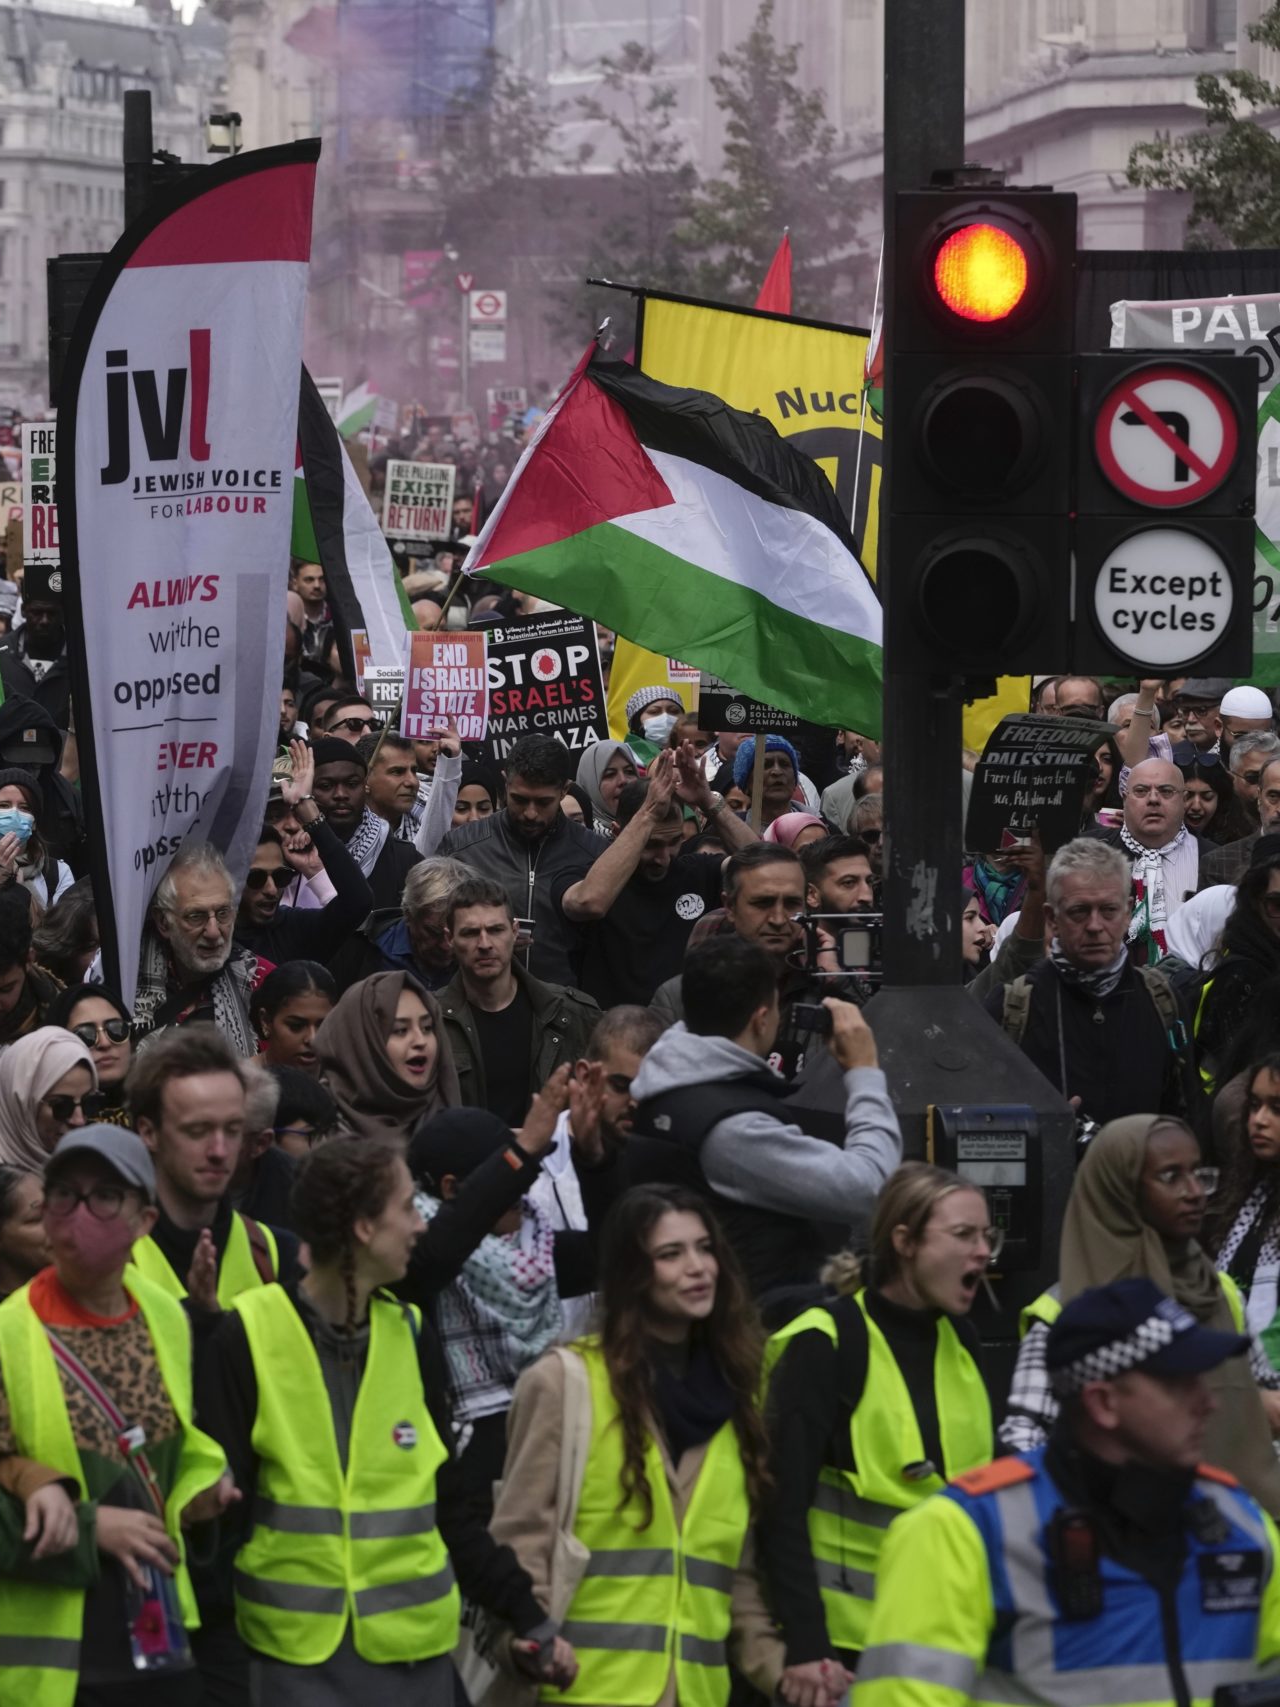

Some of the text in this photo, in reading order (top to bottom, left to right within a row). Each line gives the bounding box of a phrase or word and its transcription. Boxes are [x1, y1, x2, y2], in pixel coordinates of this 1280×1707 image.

[133, 470, 282, 493] JEWISH VOICE
[391, 480, 450, 496] EXIST!
[151, 496, 267, 519] FOR LABOUR
[390, 494, 448, 509] RESIST!
[388, 505, 447, 533] RETURN!
[1109, 567, 1222, 601] Except
[1112, 605, 1216, 635] cycles
[507, 630, 538, 641] Palestinian
[539, 628, 557, 636] Forum
[564, 624, 584, 632] Britain
[433, 644, 468, 667] END
[488, 645, 590, 689] STOP
[412, 667, 484, 691] ISRAELI
[420, 691, 475, 714] STATE
[488, 705, 598, 734] WAR CRIMES
[749, 719, 798, 727] CAMPAIGN
[1000, 725, 1099, 745] FREEDOM
[1033, 743, 1050, 751] for
